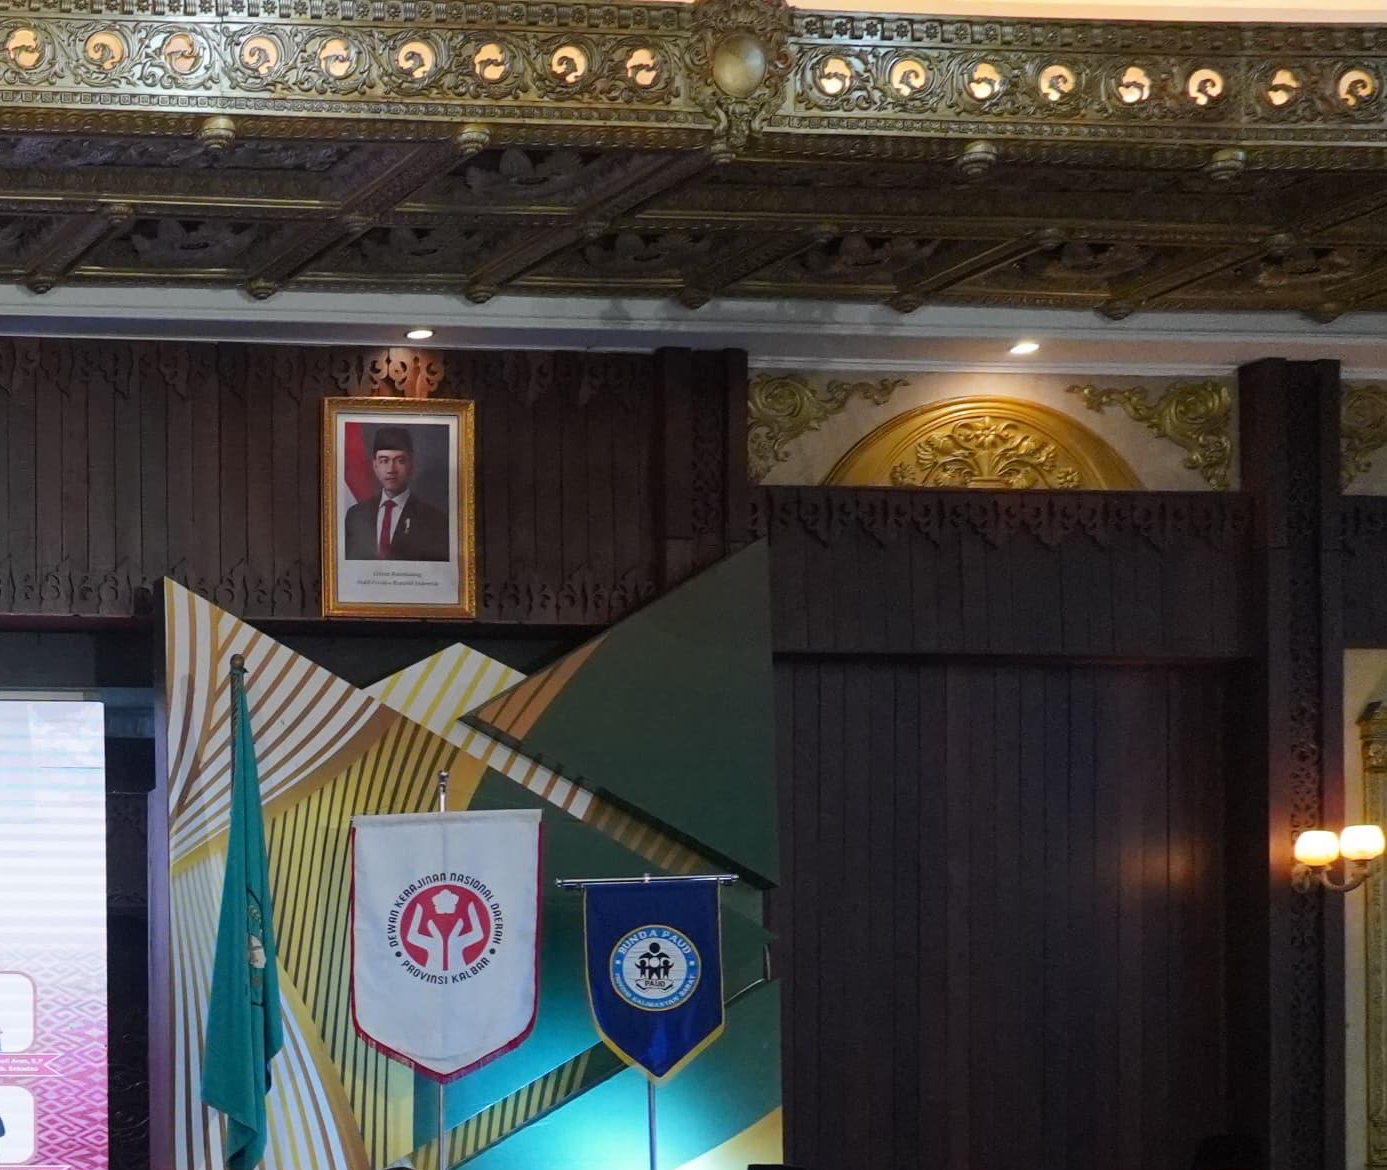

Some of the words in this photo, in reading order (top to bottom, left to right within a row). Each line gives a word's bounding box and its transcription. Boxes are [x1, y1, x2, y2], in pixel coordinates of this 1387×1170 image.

[387, 909, 399, 948] DEWAN
[394, 872, 447, 909] KERAJINAN
[449, 872, 494, 902] NASIONAL
[490, 902, 504, 945] DAERAH
[617, 929, 658, 955] BUNDA
[661, 930, 692, 954] PAUD
[400, 959, 448, 985] PROVINSI
[451, 957, 491, 984] KALBAR
